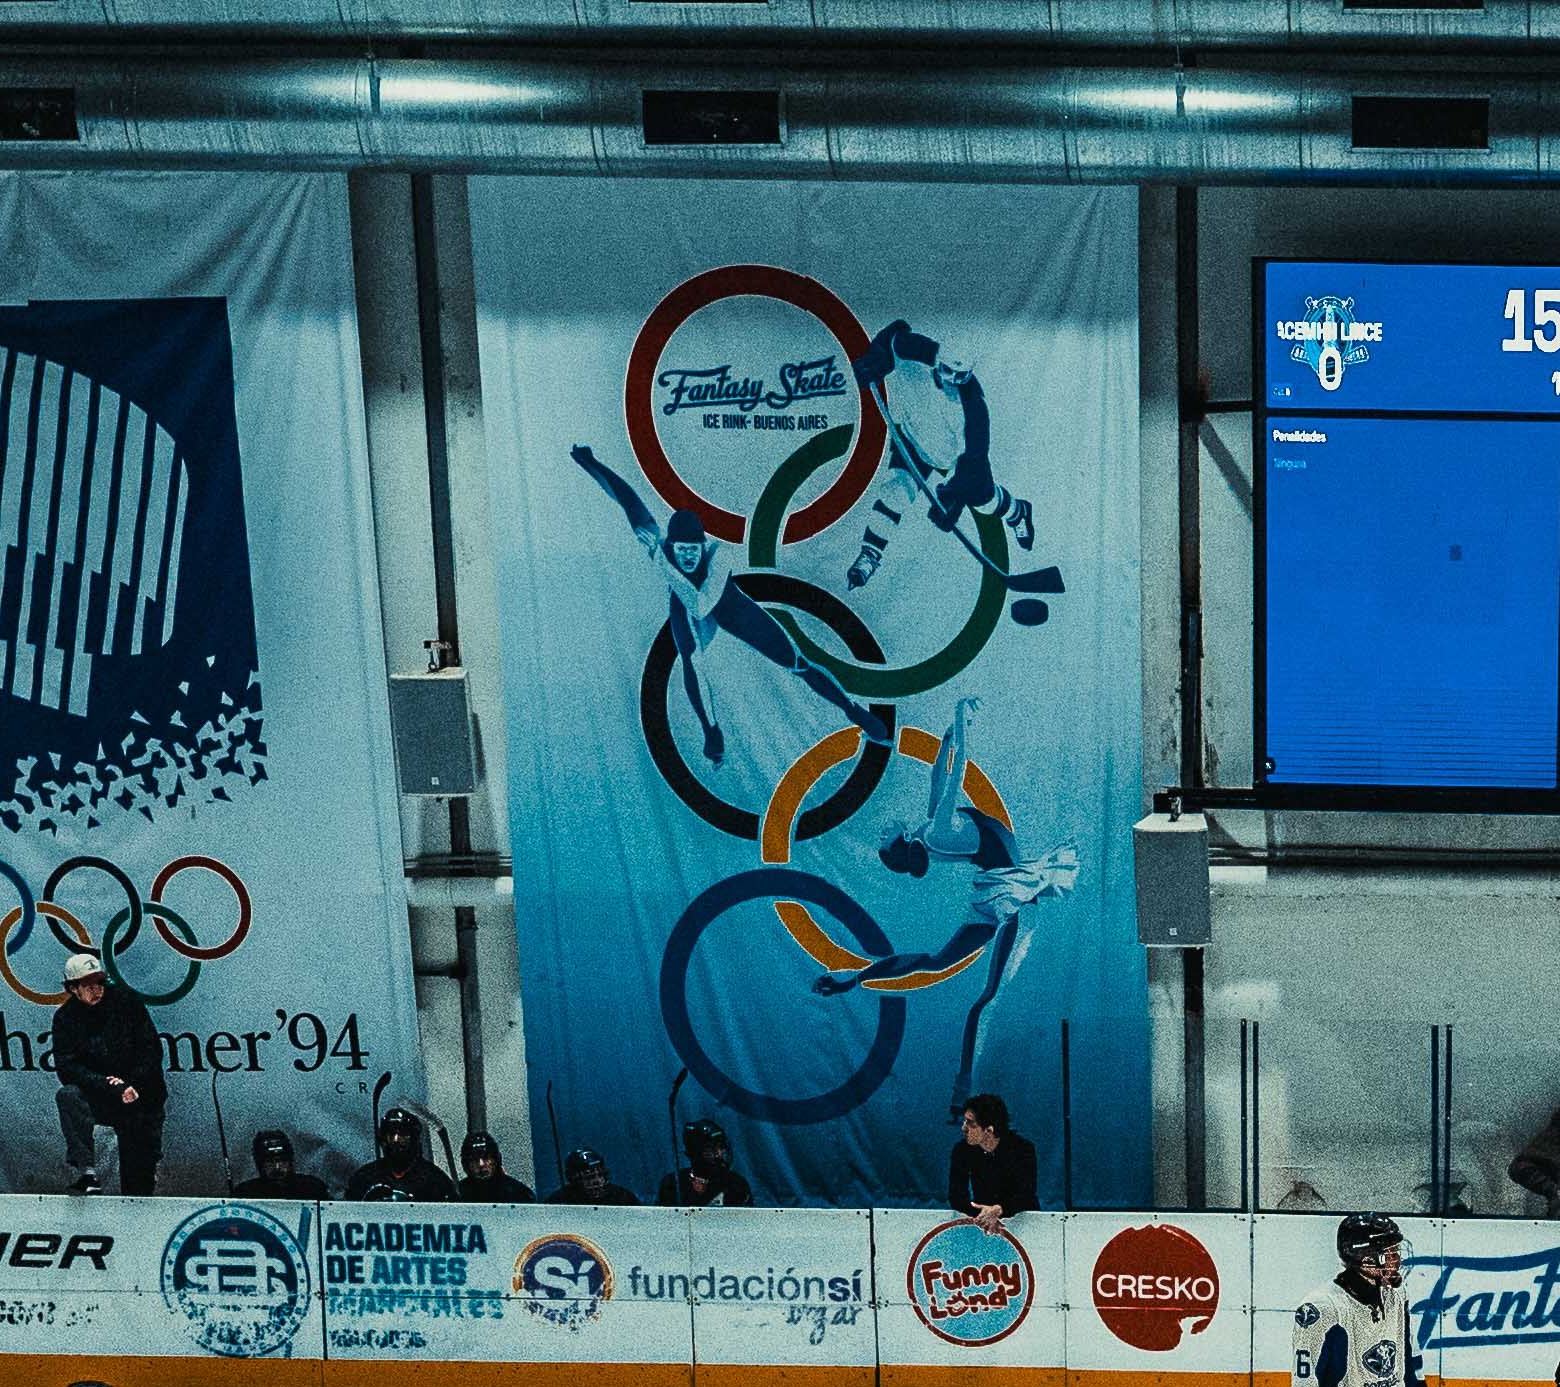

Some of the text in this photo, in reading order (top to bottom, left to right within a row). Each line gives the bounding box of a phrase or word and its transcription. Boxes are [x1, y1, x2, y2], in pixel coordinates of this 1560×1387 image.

[658, 354, 847, 415] Fantasy Skate
[1318, 347, 1342, 391] 0
[703, 414, 720, 429] ICE
[754, 415, 795, 430] BUENOS
[797, 415, 828, 430] AIRES
[325, 1222, 488, 1254] ACADEMIA
[326, 1255, 468, 1287] DE ARTES
[921, 1260, 1022, 1298] Funny
[1096, 1272, 1215, 1301] CRESKO
